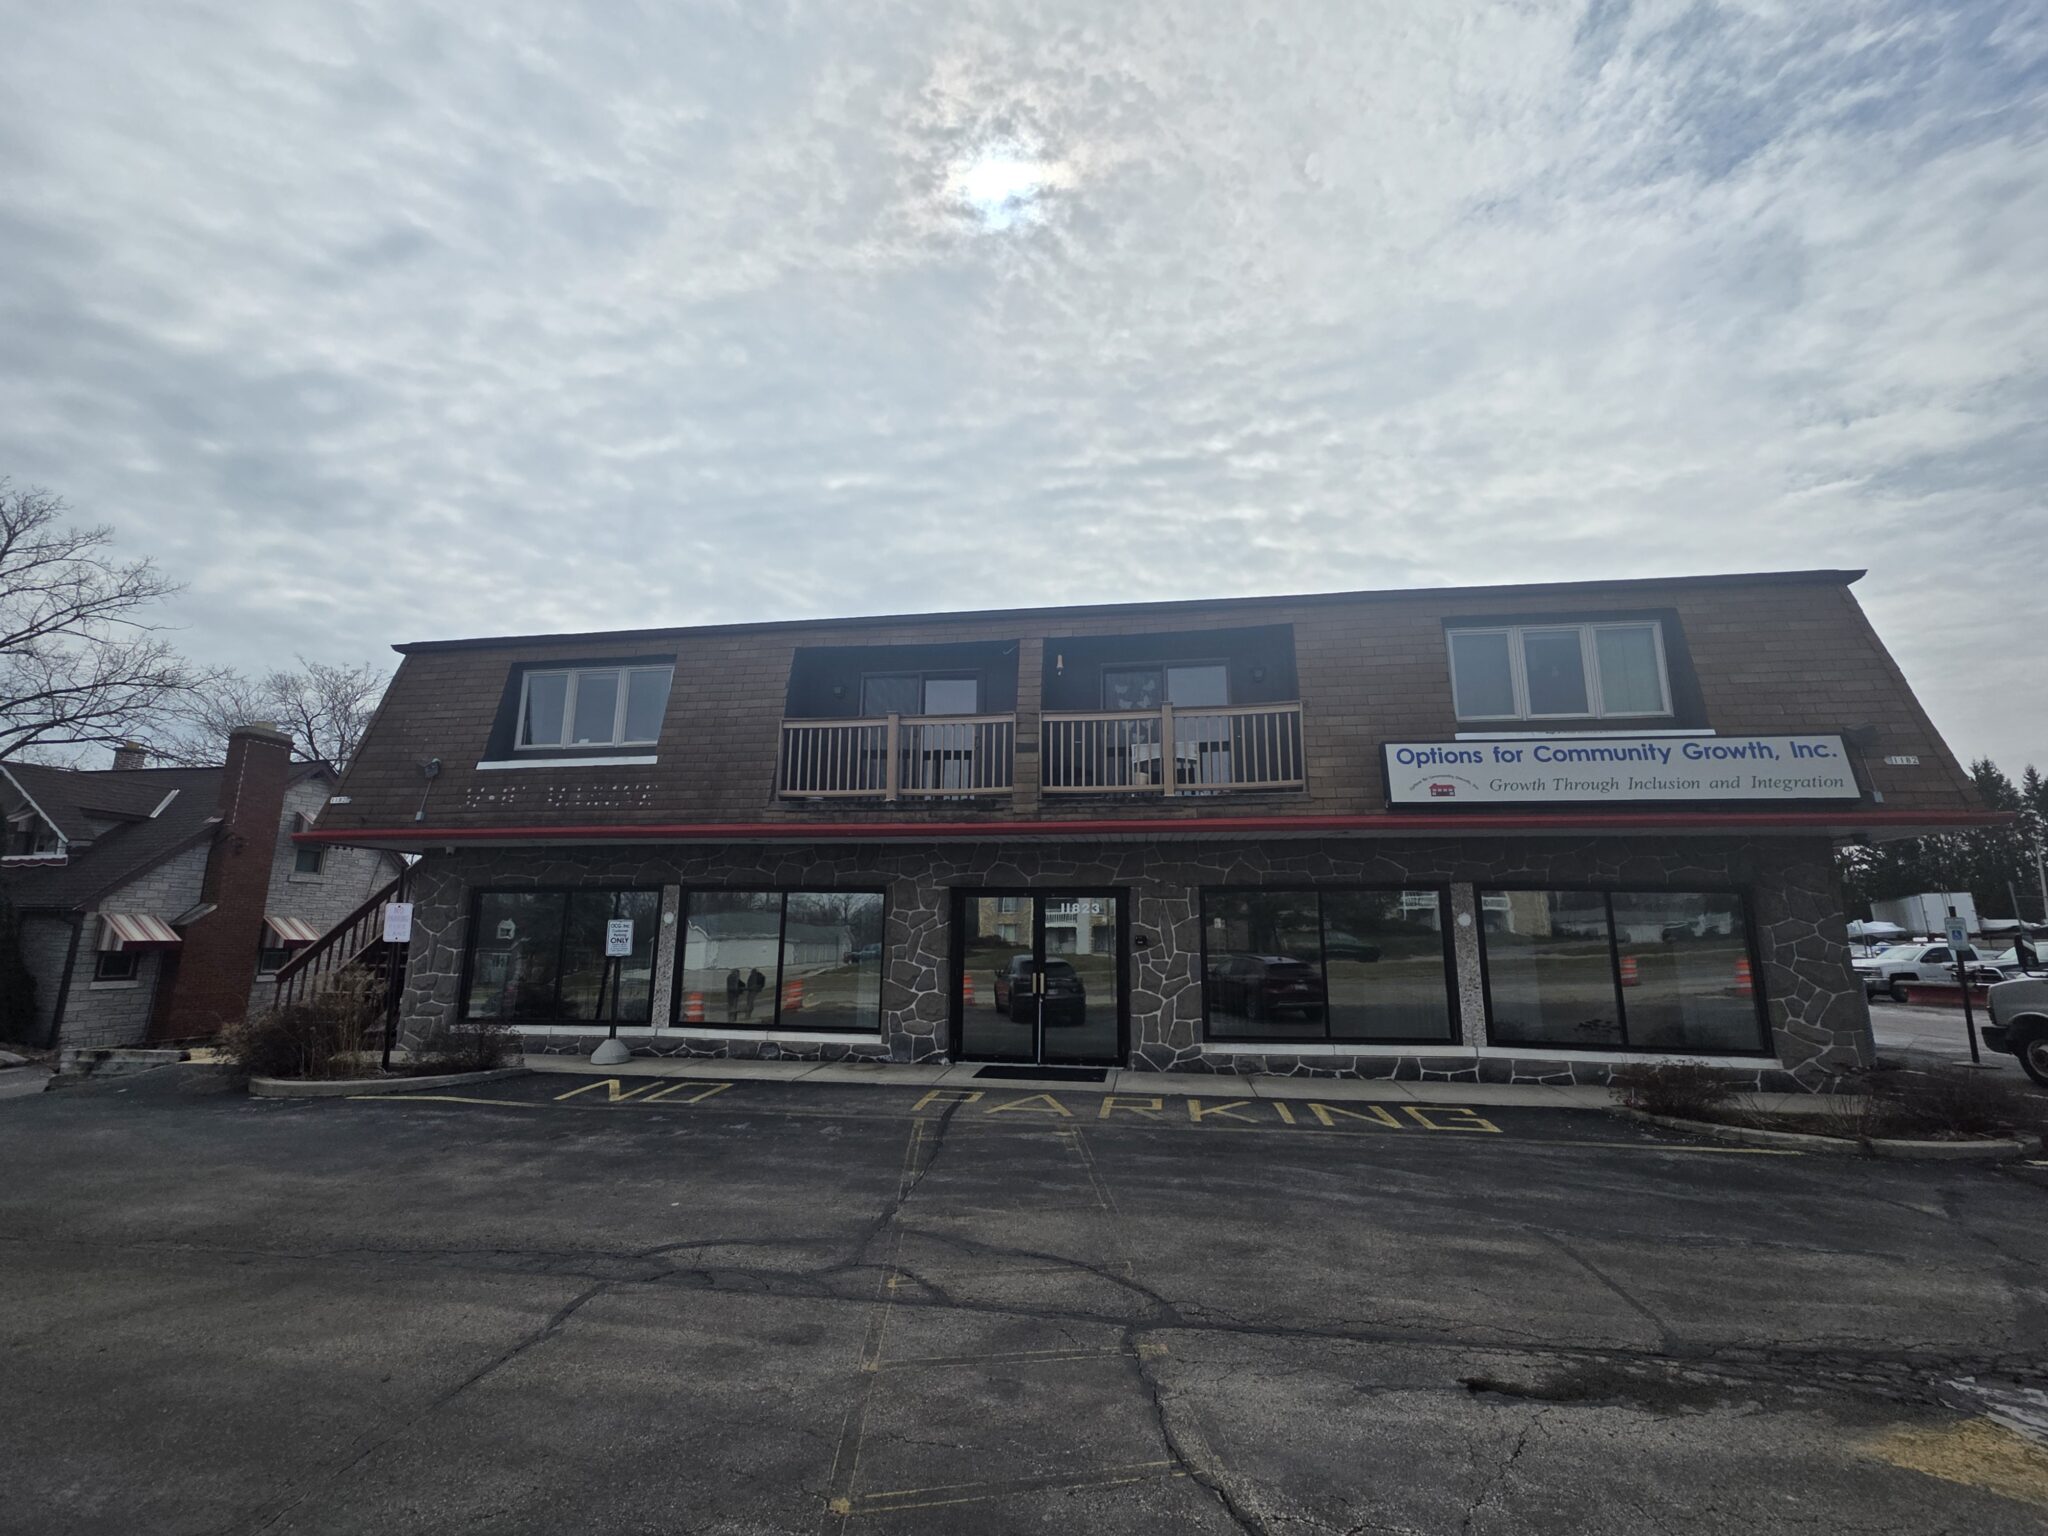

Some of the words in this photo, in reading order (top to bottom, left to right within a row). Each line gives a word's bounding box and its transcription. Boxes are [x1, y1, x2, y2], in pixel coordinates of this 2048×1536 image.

[1396, 748, 1483, 768] Options
[1494, 746, 1523, 763] for
[1534, 743, 1671, 765] Community
[1683, 741, 1780, 761] Growth,
[1790, 741, 1838, 759] Inc.
[1489, 777, 1546, 792] Growth
[1553, 776, 1619, 793] Through
[1628, 776, 1700, 790] Inclusion
[1709, 776, 1741, 789] and
[1751, 775, 1844, 792] Integration
[1060, 902, 1100, 914] 11823
[553, 1079, 734, 1102] NO
[911, 1089, 1502, 1133] PARKING
